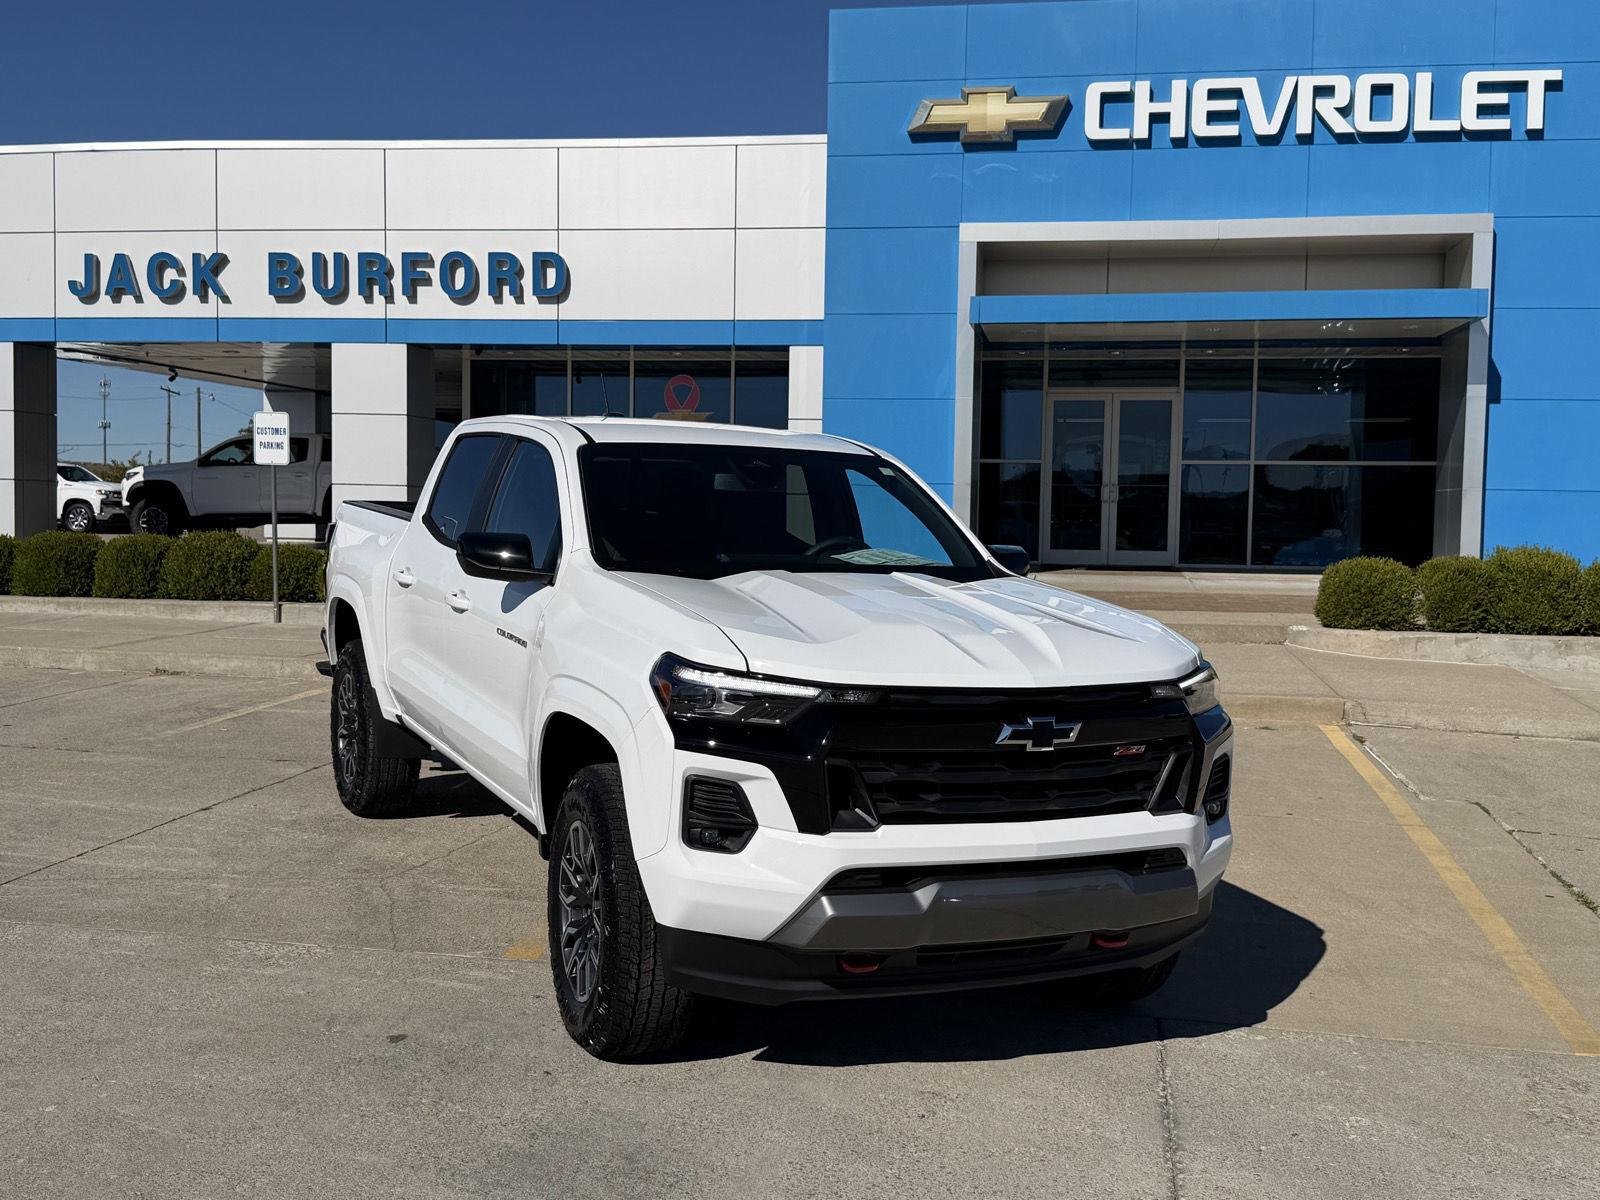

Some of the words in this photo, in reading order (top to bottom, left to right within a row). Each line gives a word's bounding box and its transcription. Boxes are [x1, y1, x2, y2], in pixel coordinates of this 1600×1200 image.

[1084, 69, 1563, 143] CHEVROLET
[68, 252, 231, 304] JACK
[268, 251, 571, 305] BURFORD
[256, 426, 287, 436] CUSTOMER
[259, 441, 285, 450] PARKING
